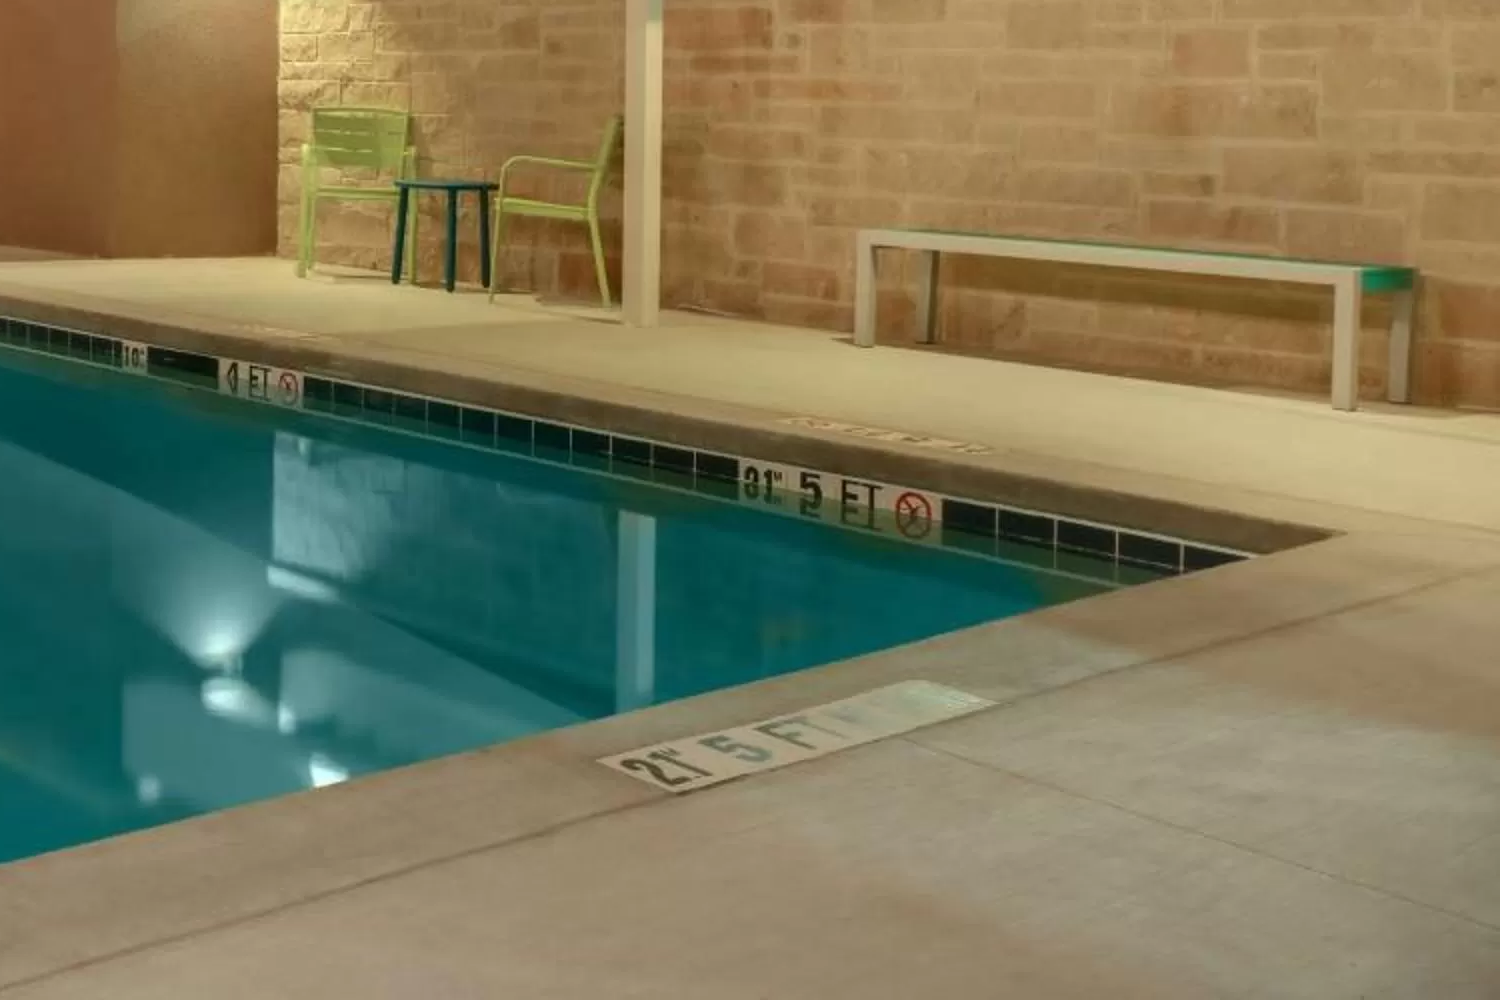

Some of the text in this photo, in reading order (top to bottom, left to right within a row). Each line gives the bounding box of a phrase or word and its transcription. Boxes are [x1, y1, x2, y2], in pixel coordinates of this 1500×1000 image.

[800, 472, 822, 508] 5
[841, 479, 883, 512] FT
[697, 735, 773, 763] 5
[752, 716, 850, 751] FT
